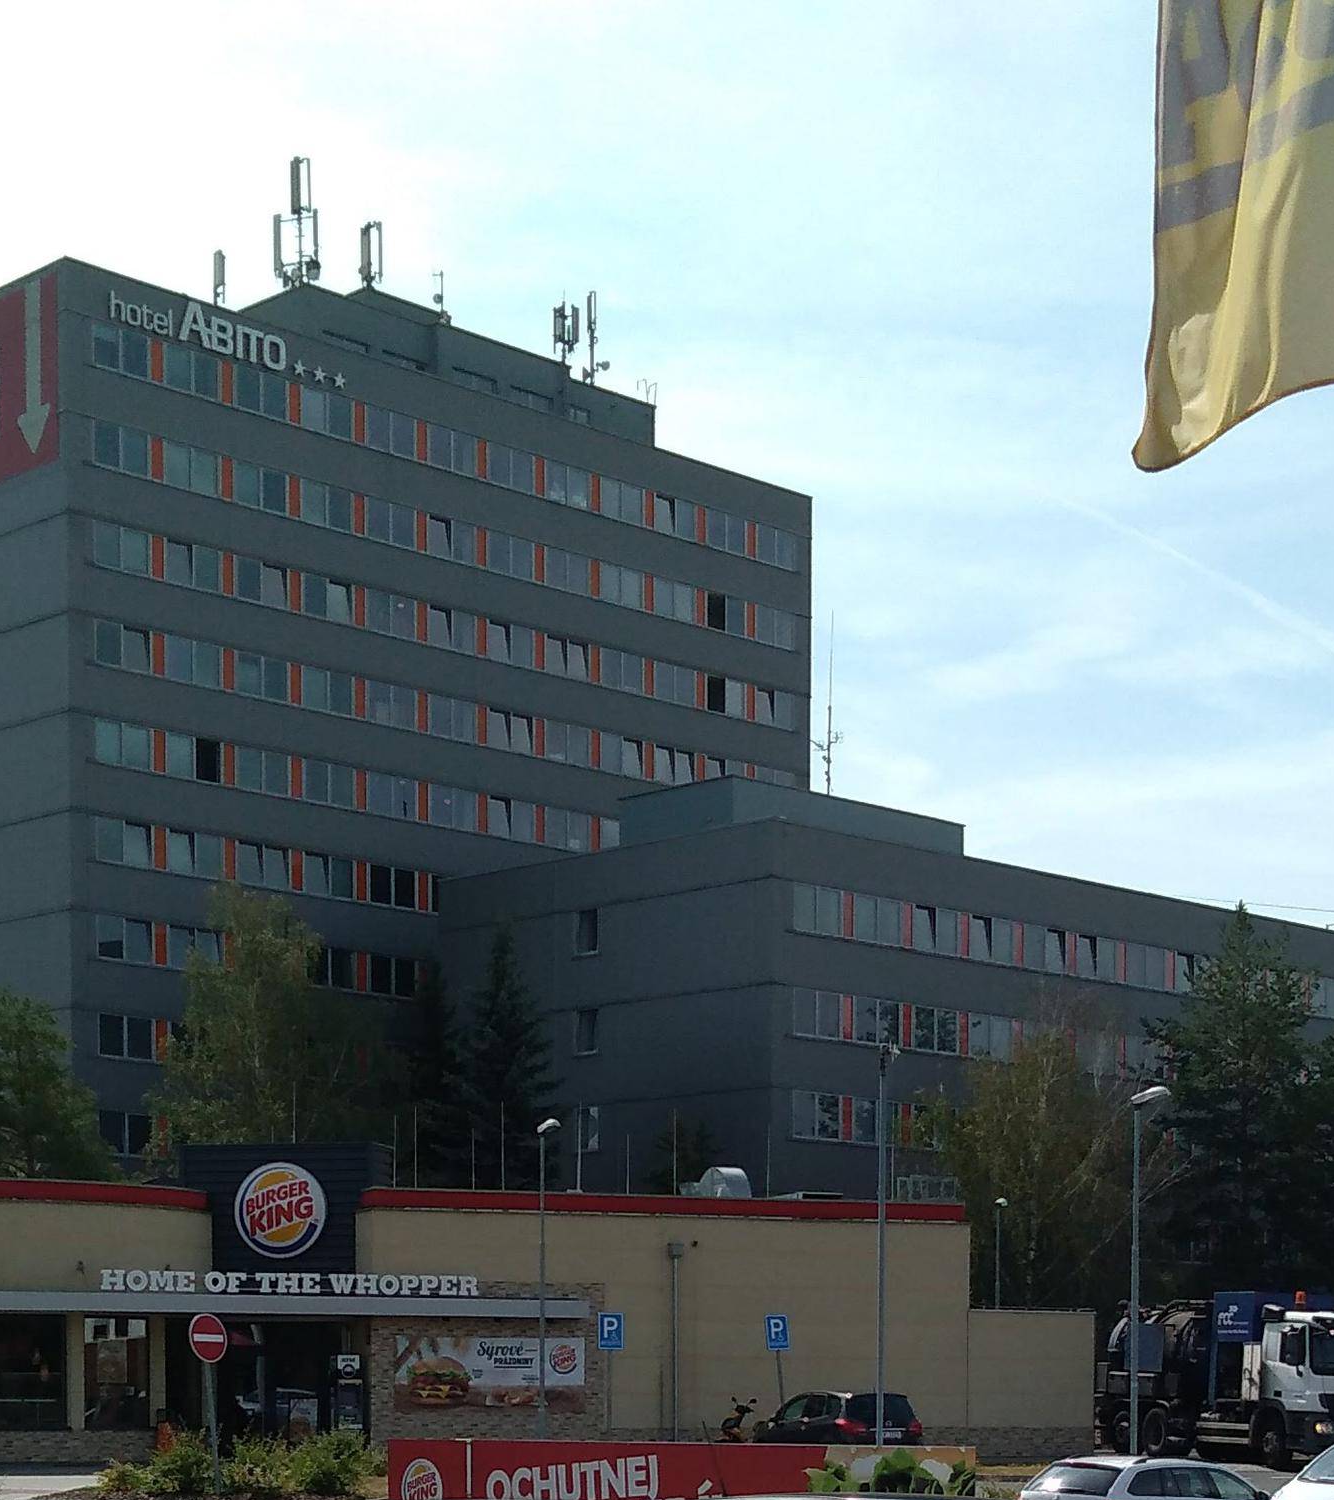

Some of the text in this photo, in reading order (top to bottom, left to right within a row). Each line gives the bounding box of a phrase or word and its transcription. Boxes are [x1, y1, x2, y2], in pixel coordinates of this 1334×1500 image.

[109, 290, 287, 372] hotel ABITO
[244, 1180, 311, 1215] BURGER
[248, 1198, 315, 1239] KING
[100, 1269, 479, 1297] HOME OF THE WHOPPER
[603, 1316, 618, 1339] P
[770, 1318, 784, 1339] P
[477, 1341, 524, 1360] Syrové
[554, 1354, 577, 1369] KING
[406, 1469, 437, 1490] BURGER
[486, 1455, 659, 1500] OCHUTNEJ
